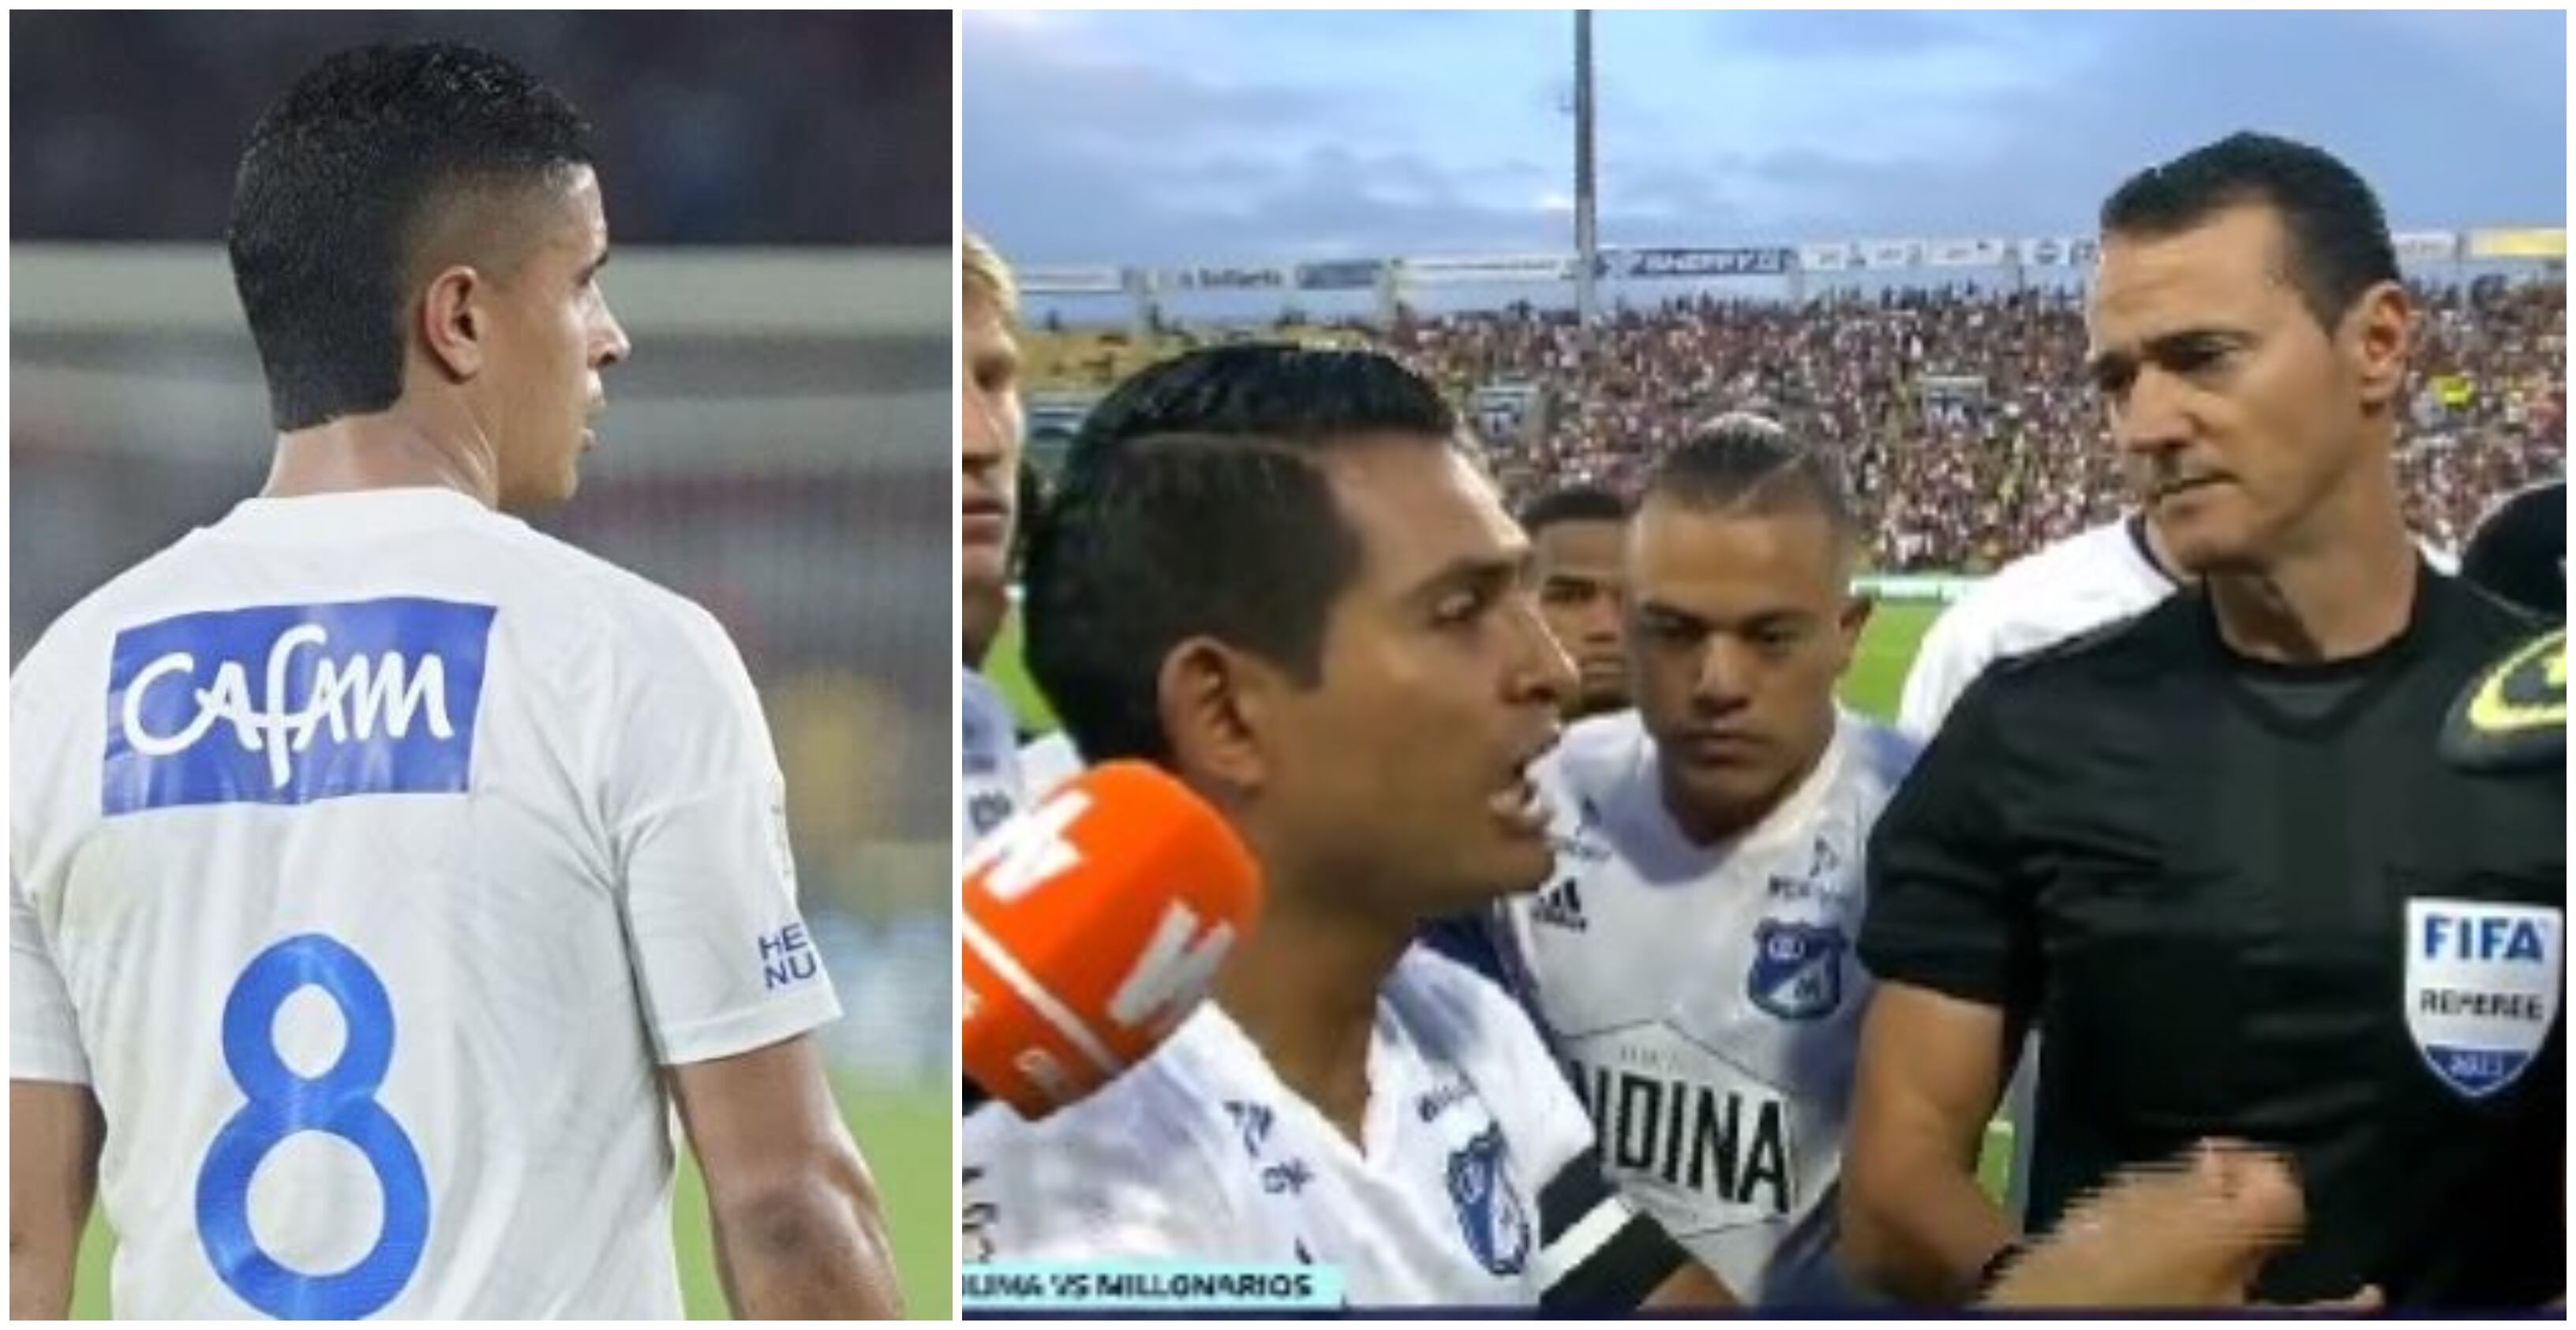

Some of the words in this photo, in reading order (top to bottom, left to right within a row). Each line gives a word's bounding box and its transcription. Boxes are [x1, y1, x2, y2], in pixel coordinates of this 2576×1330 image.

[2424, 915, 2544, 961] FIFA
[2420, 988, 2544, 1021] REFEREE
[195, 933, 431, 1321] 8
